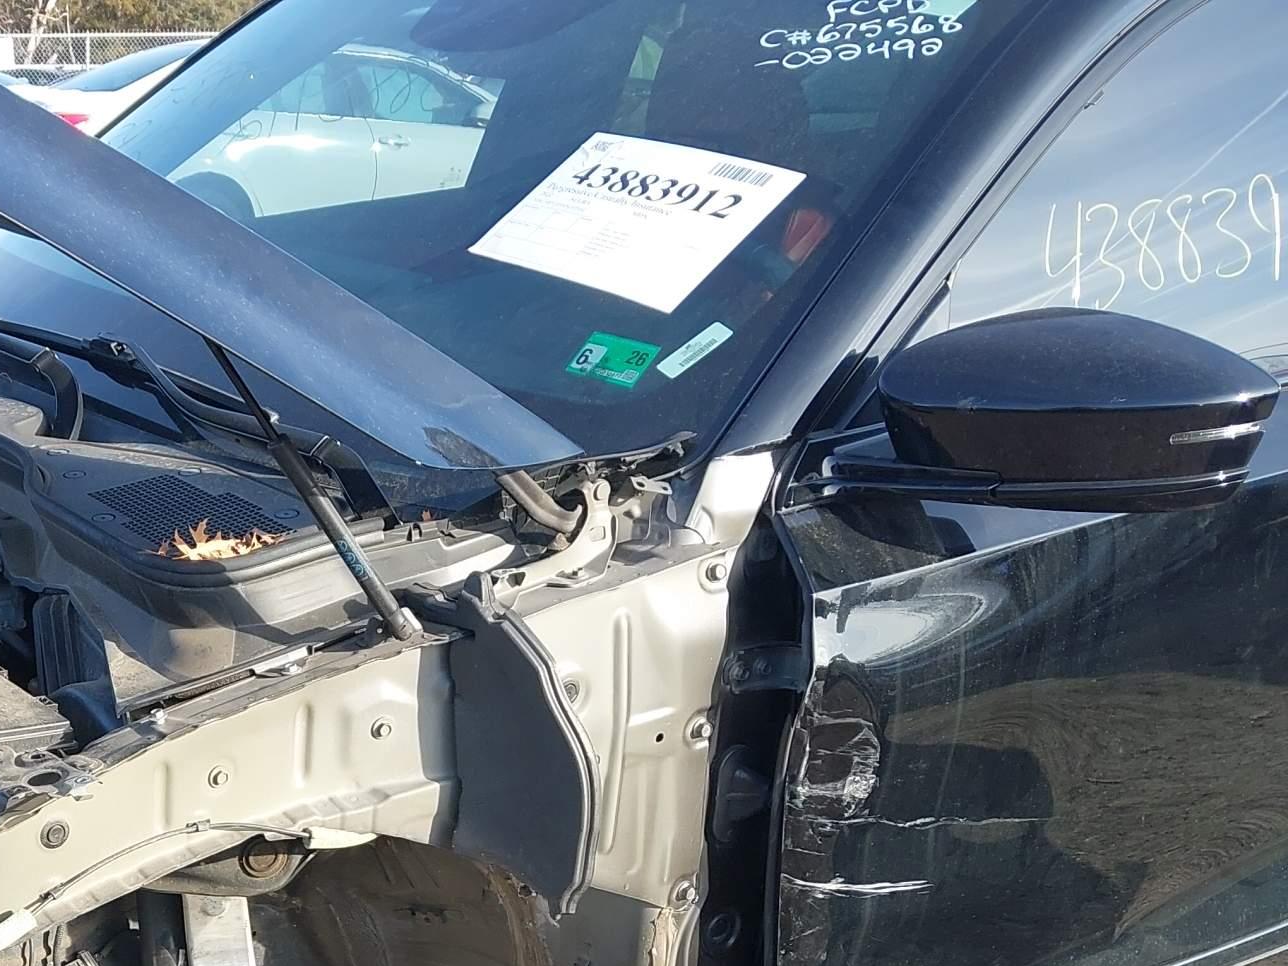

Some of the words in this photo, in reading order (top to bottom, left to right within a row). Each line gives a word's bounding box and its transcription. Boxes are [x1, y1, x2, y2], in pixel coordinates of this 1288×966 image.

[759, 14, 963, 48] C#675568
[571, 162, 743, 220] 43883912
[575, 347, 594, 366] 6
[624, 349, 650, 368] 26
